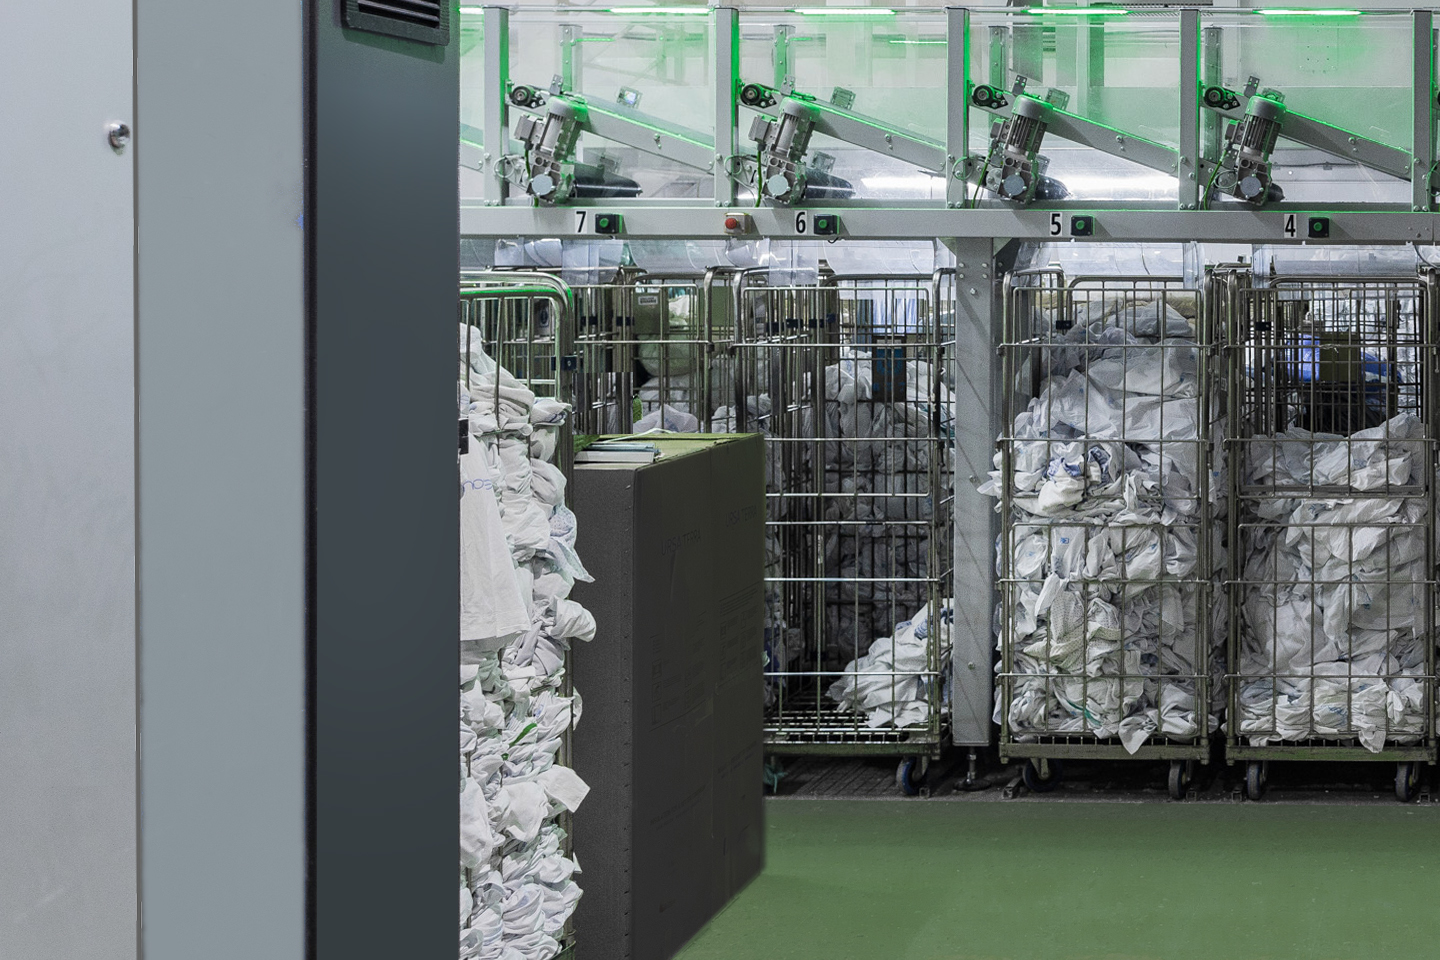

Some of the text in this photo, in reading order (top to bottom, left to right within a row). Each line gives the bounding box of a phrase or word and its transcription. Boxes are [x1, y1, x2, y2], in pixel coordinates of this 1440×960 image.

[575, 210, 587, 233] 7
[795, 211, 806, 234] 6
[1050, 213, 1062, 236] 5
[1284, 214, 1296, 238] 4
[660, 528, 702, 556] URSA TERRA
